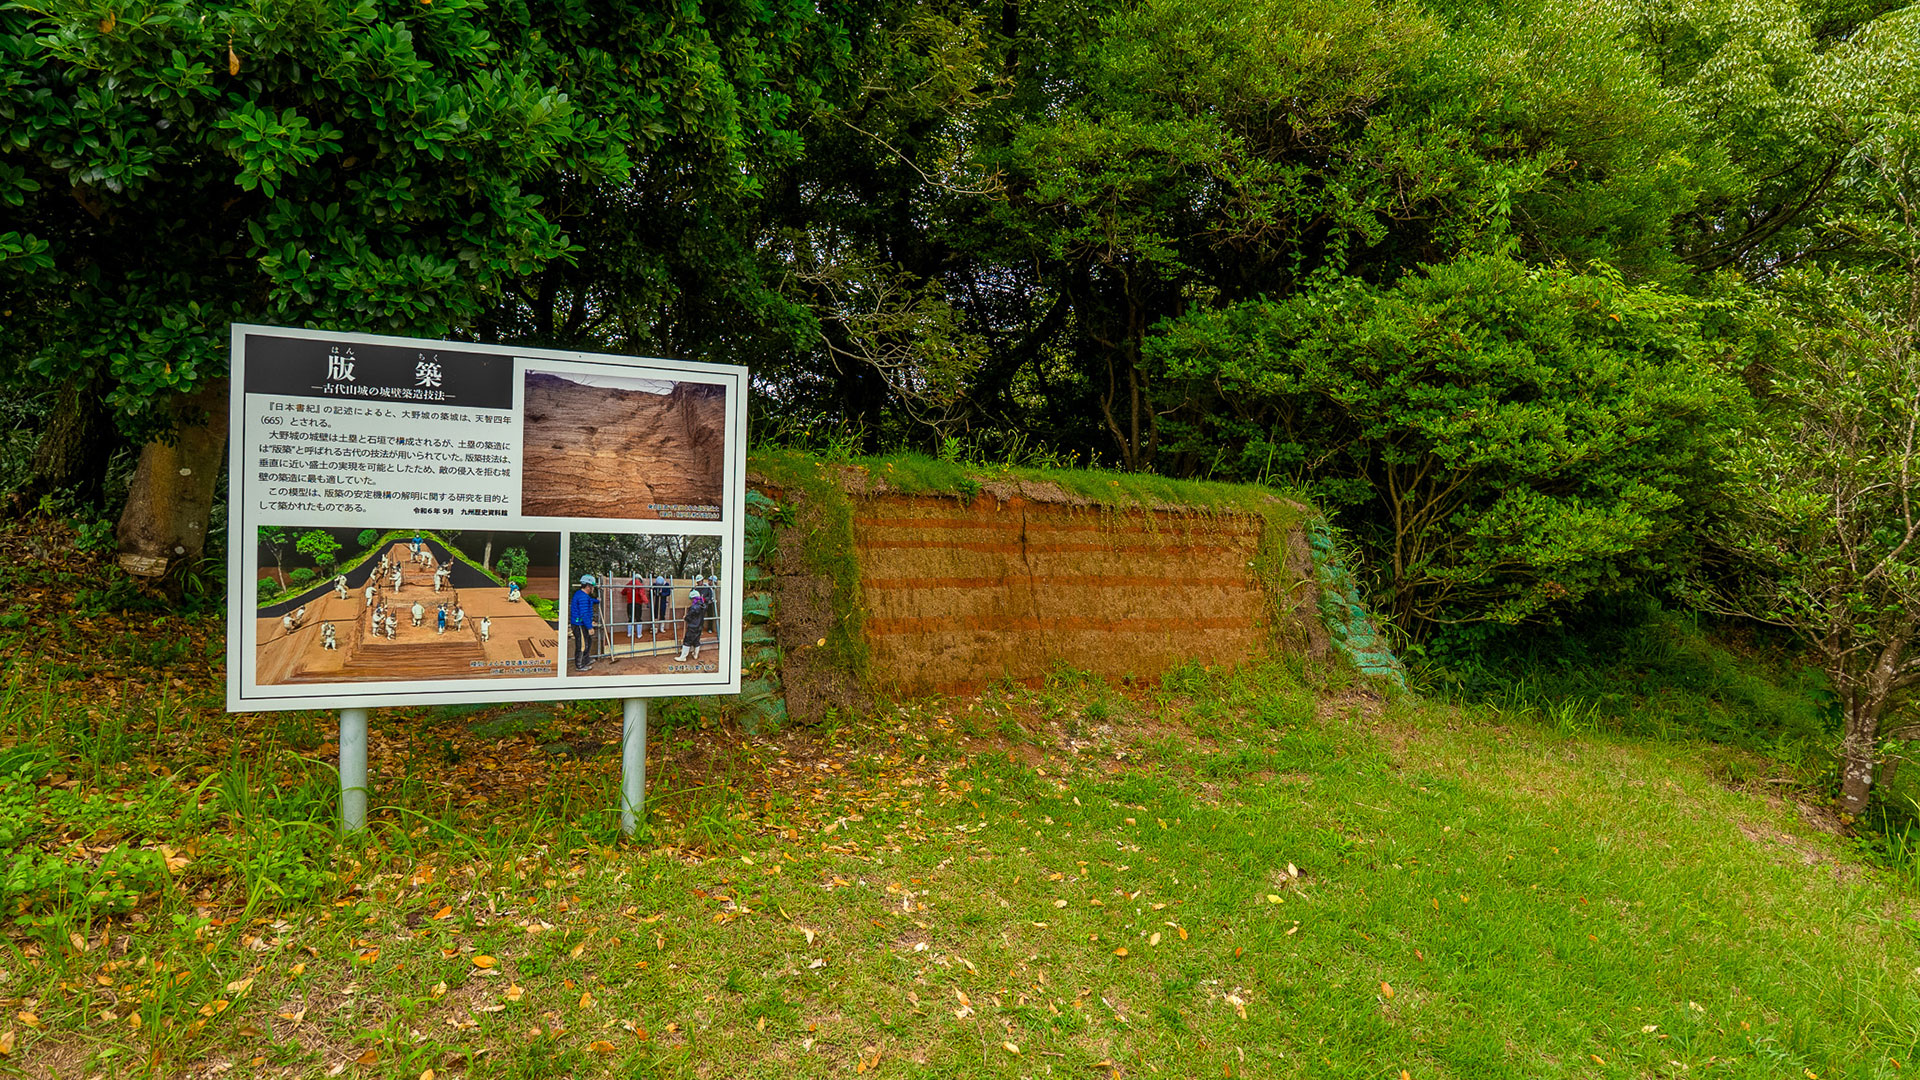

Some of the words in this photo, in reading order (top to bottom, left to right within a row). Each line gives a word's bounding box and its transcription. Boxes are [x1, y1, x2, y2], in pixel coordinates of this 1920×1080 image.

[258, 472, 376, 486] 壁の築造に最も適していた。
[259, 501, 367, 513] して築かれたものである。
